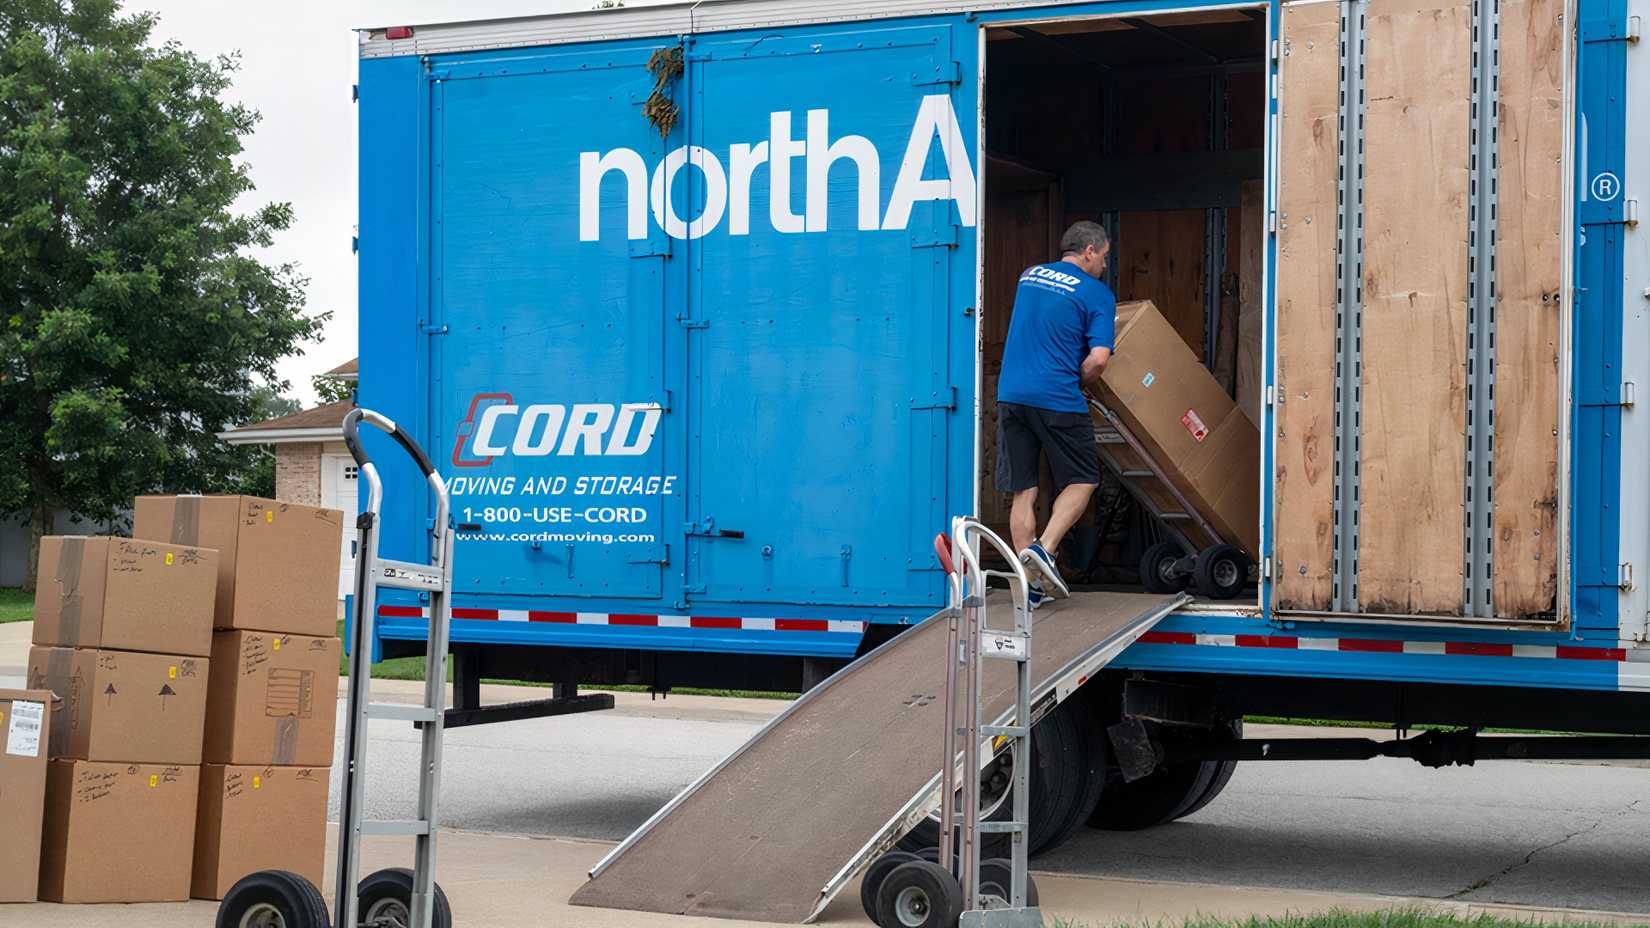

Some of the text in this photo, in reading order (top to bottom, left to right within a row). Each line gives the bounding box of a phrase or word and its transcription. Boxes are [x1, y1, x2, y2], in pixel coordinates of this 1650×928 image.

[579, 94, 977, 241] northA
[1028, 266, 1081, 286] CORD
[472, 403, 662, 456] CORD
[521, 477, 567, 495] AND
[574, 476, 677, 495] STORAGE
[463, 507, 647, 523] 1-800-USE-CORD
[456, 532, 655, 543] www.cordmoving.com
